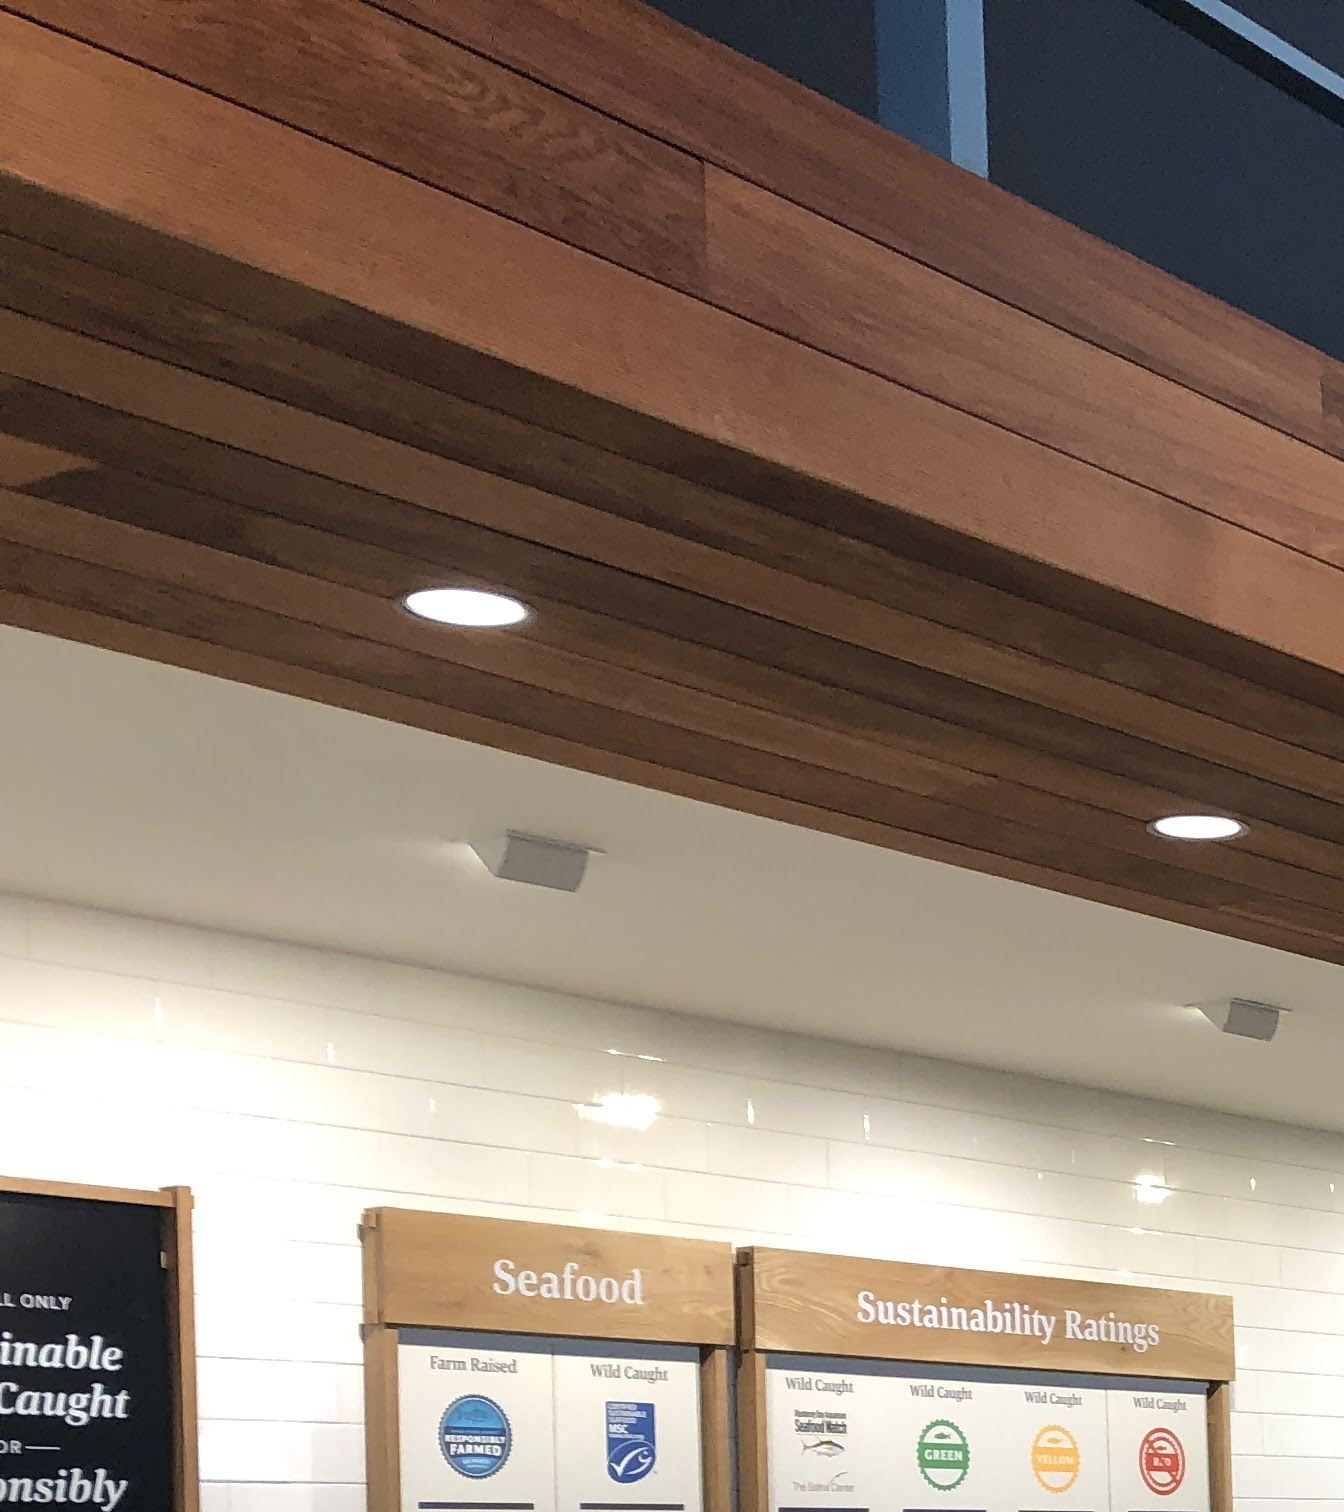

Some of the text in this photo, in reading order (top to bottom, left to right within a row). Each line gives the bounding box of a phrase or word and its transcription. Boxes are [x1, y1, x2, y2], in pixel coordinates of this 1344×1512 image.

[492, 1258, 645, 1306] Seafood
[20, 1293, 73, 1311] ONLY
[856, 1290, 1160, 1353] Sustainability Ratings
[430, 1355, 518, 1374] Farm Raised
[590, 1364, 669, 1384] Wild Caught
[785, 1377, 854, 1396] Wild Caught
[910, 1384, 972, 1402] Wild Caught
[0, 1381, 131, 1426] Caught
[1024, 1391, 1082, 1408] Wild Caught
[1133, 1397, 1187, 1413] Wild Caught
[608, 1423, 629, 1434] MSC
[450, 1444, 502, 1456] FARMED
[924, 1448, 963, 1462] GREEN
[1037, 1454, 1075, 1465] YELLOW
